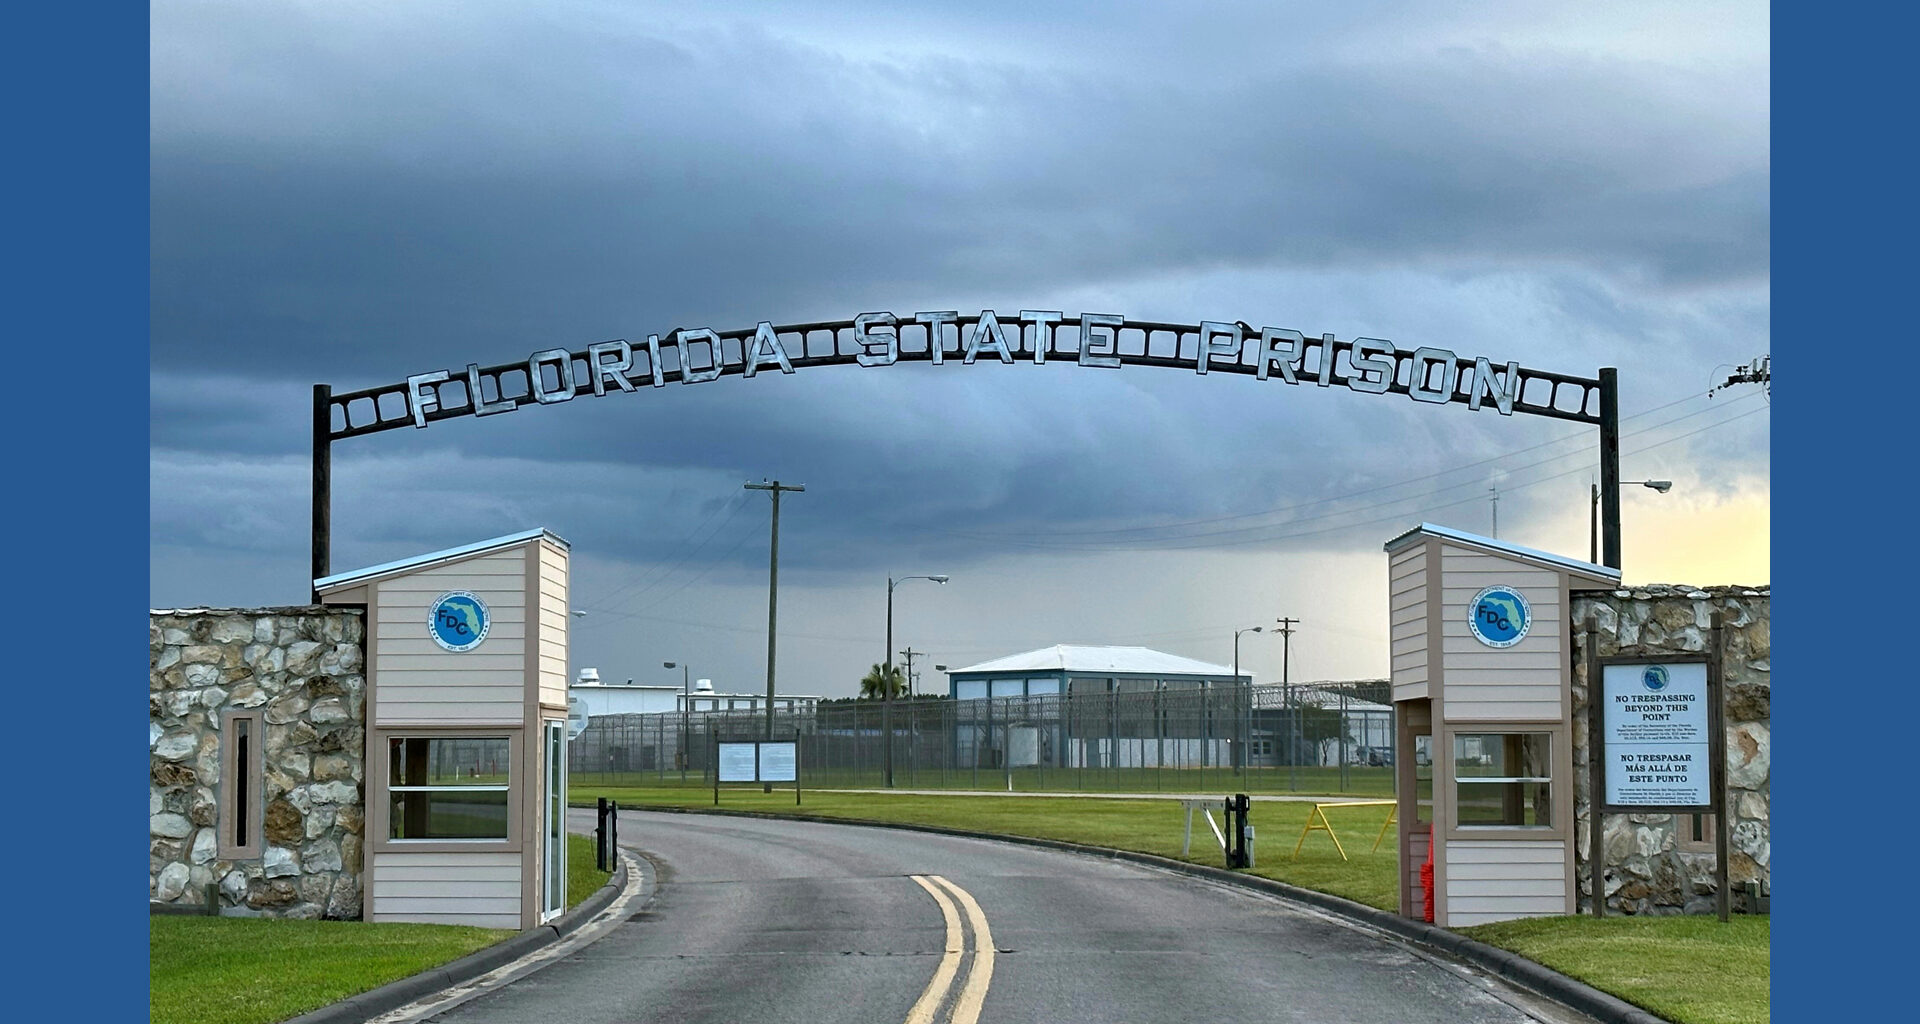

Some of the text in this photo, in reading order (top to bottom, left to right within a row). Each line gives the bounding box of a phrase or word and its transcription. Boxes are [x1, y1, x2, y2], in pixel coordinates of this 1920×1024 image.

[407, 310, 1520, 428] FLORIDA STATE PRISON
[438, 609, 468, 636] FDC
[1478, 605, 1509, 631] FDC
[1615, 694, 1696, 703] NO TRESPASSING
[1624, 704, 1688, 712] BEYOND THIS
[1642, 713, 1670, 721] POINT
[1621, 754, 1692, 762] NO TRESPASAR
[1625, 763, 1688, 772] MÁS ALLÁ DE
[1629, 775, 1688, 783] ESTE PUNTO
